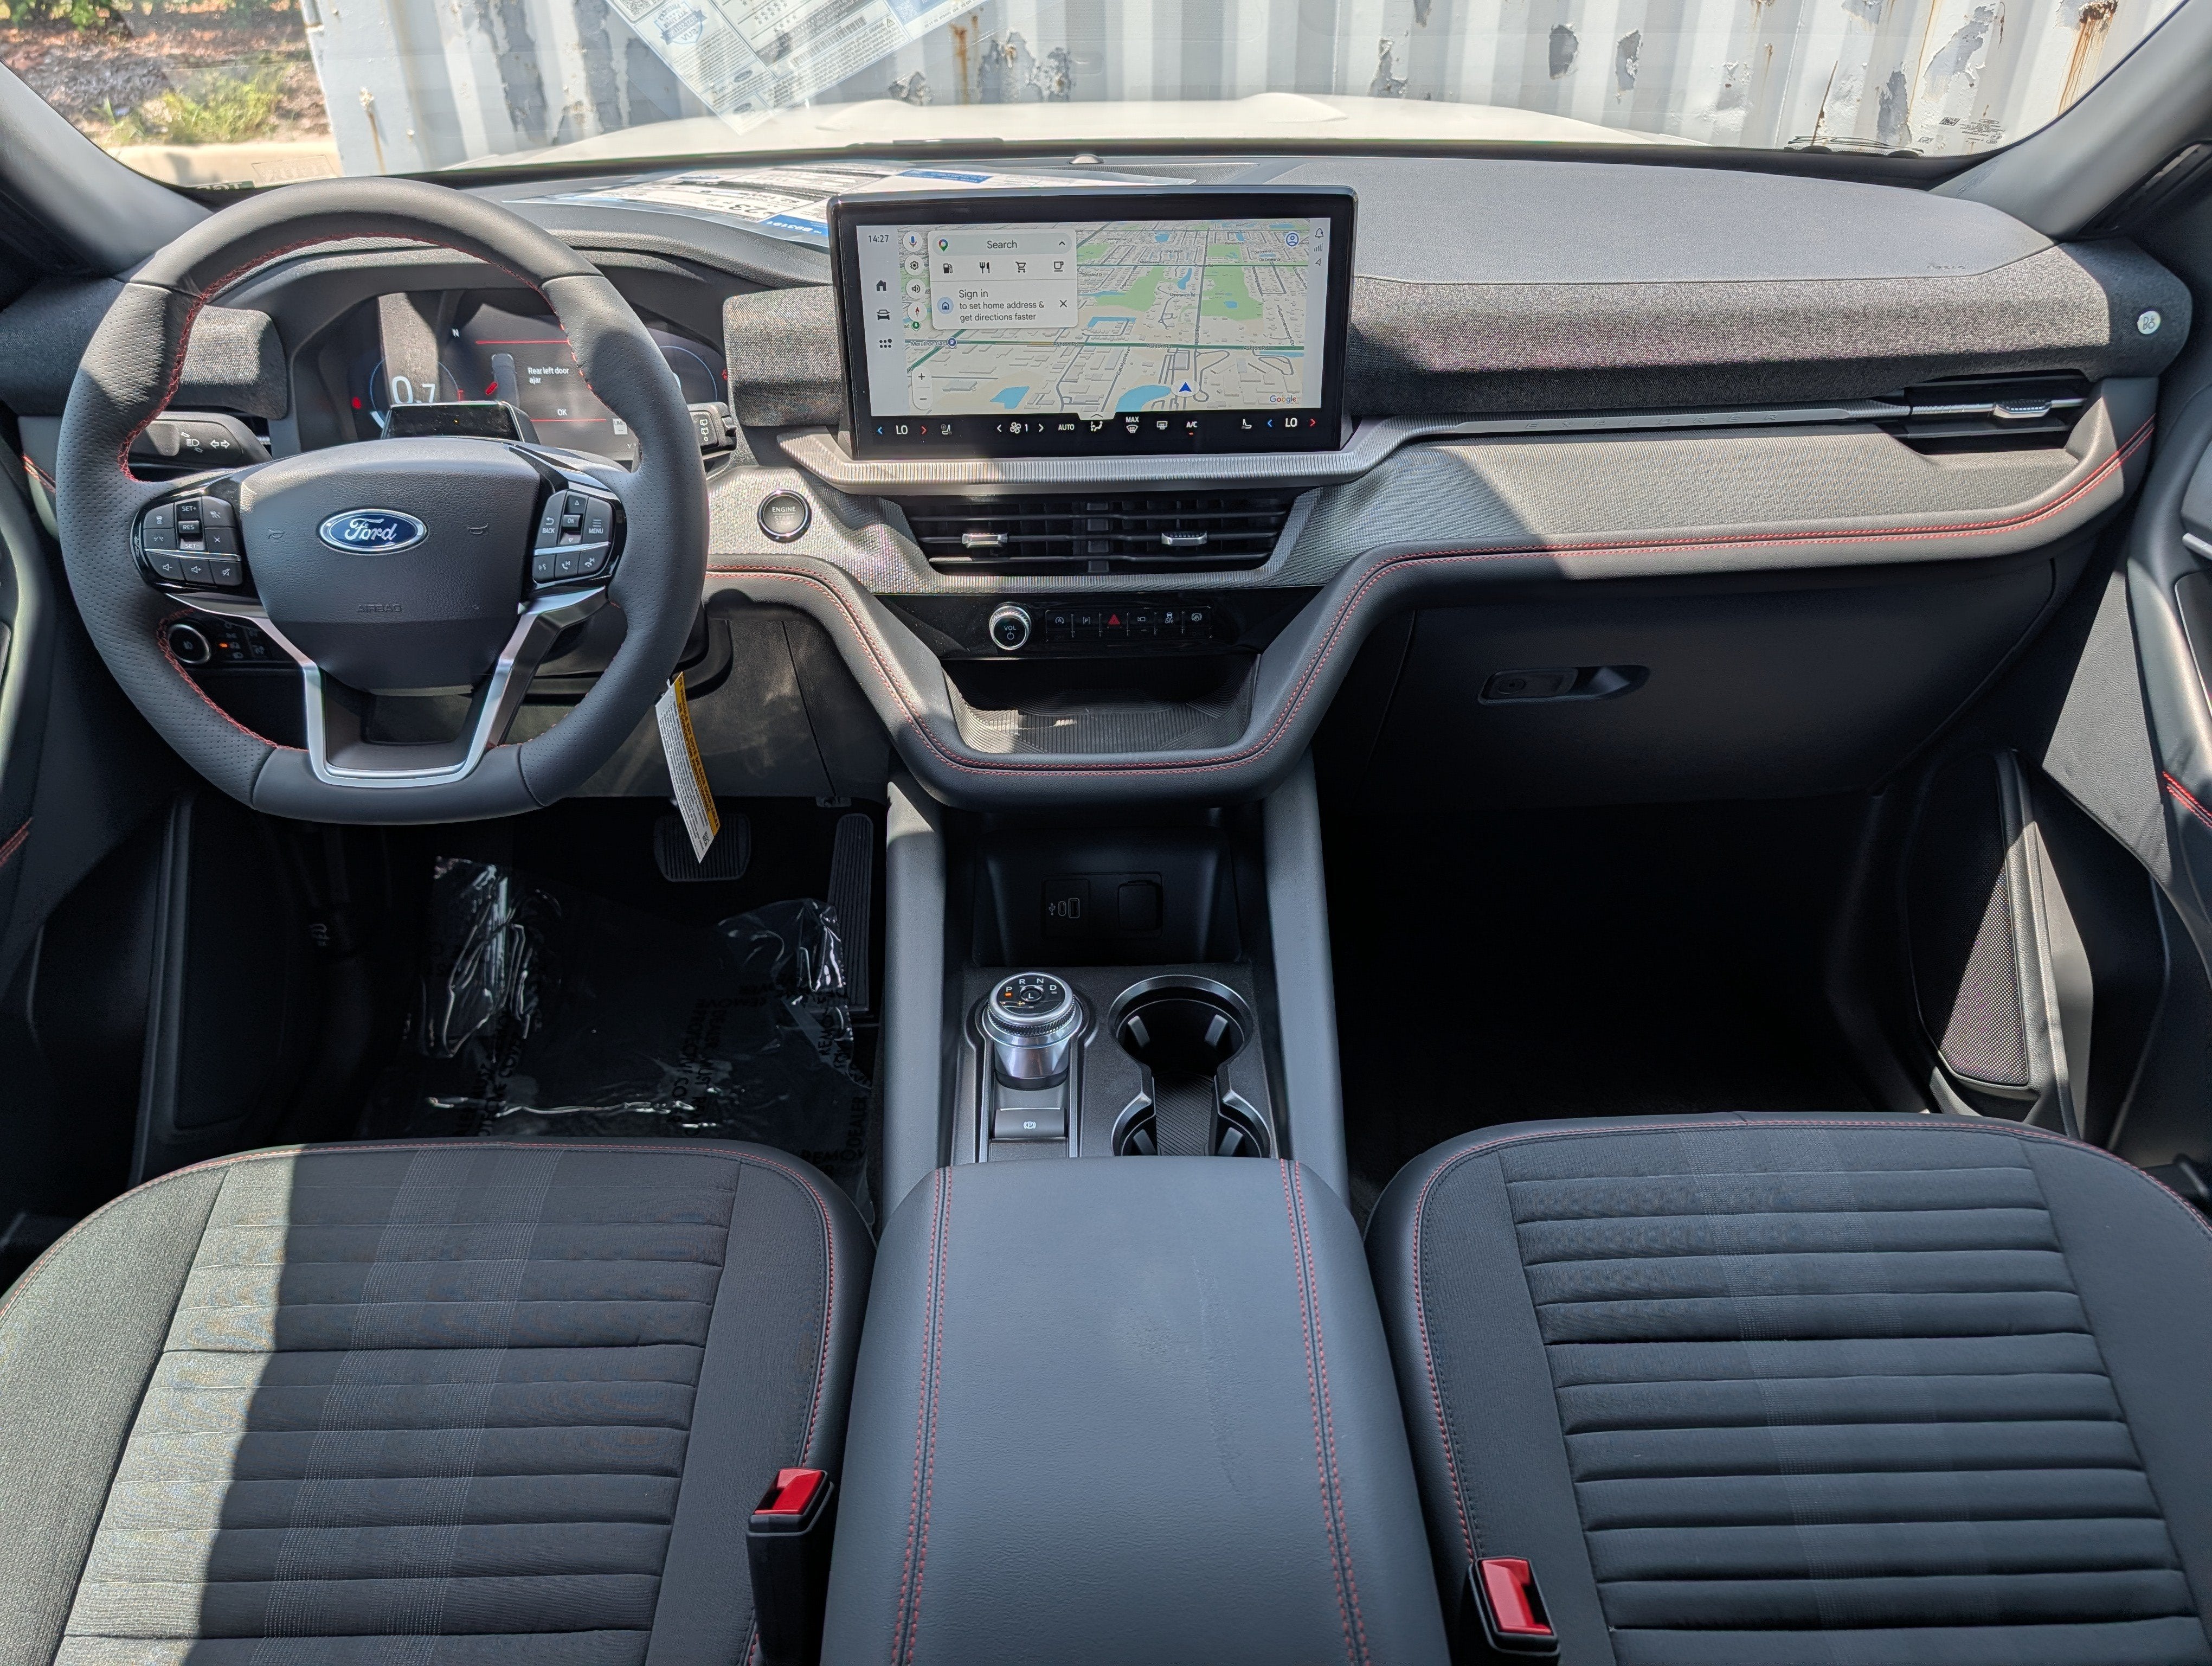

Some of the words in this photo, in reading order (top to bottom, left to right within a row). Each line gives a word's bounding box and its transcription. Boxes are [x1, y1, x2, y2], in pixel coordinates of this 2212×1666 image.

[868, 235, 889, 243] 14:27
[987, 240, 1017, 249] Search
[959, 290, 978, 300] Sign
[960, 314, 973, 323] get
[975, 313, 1012, 321] directions
[529, 376, 541, 385] ajar
[1270, 395, 1297, 405] Google
[896, 425, 908, 434] LO
[1285, 418, 1297, 427] LO
[344, 518, 398, 540] Ford
[357, 604, 402, 613] AIRBAG
[846, 1096, 868, 1147] DEALER
